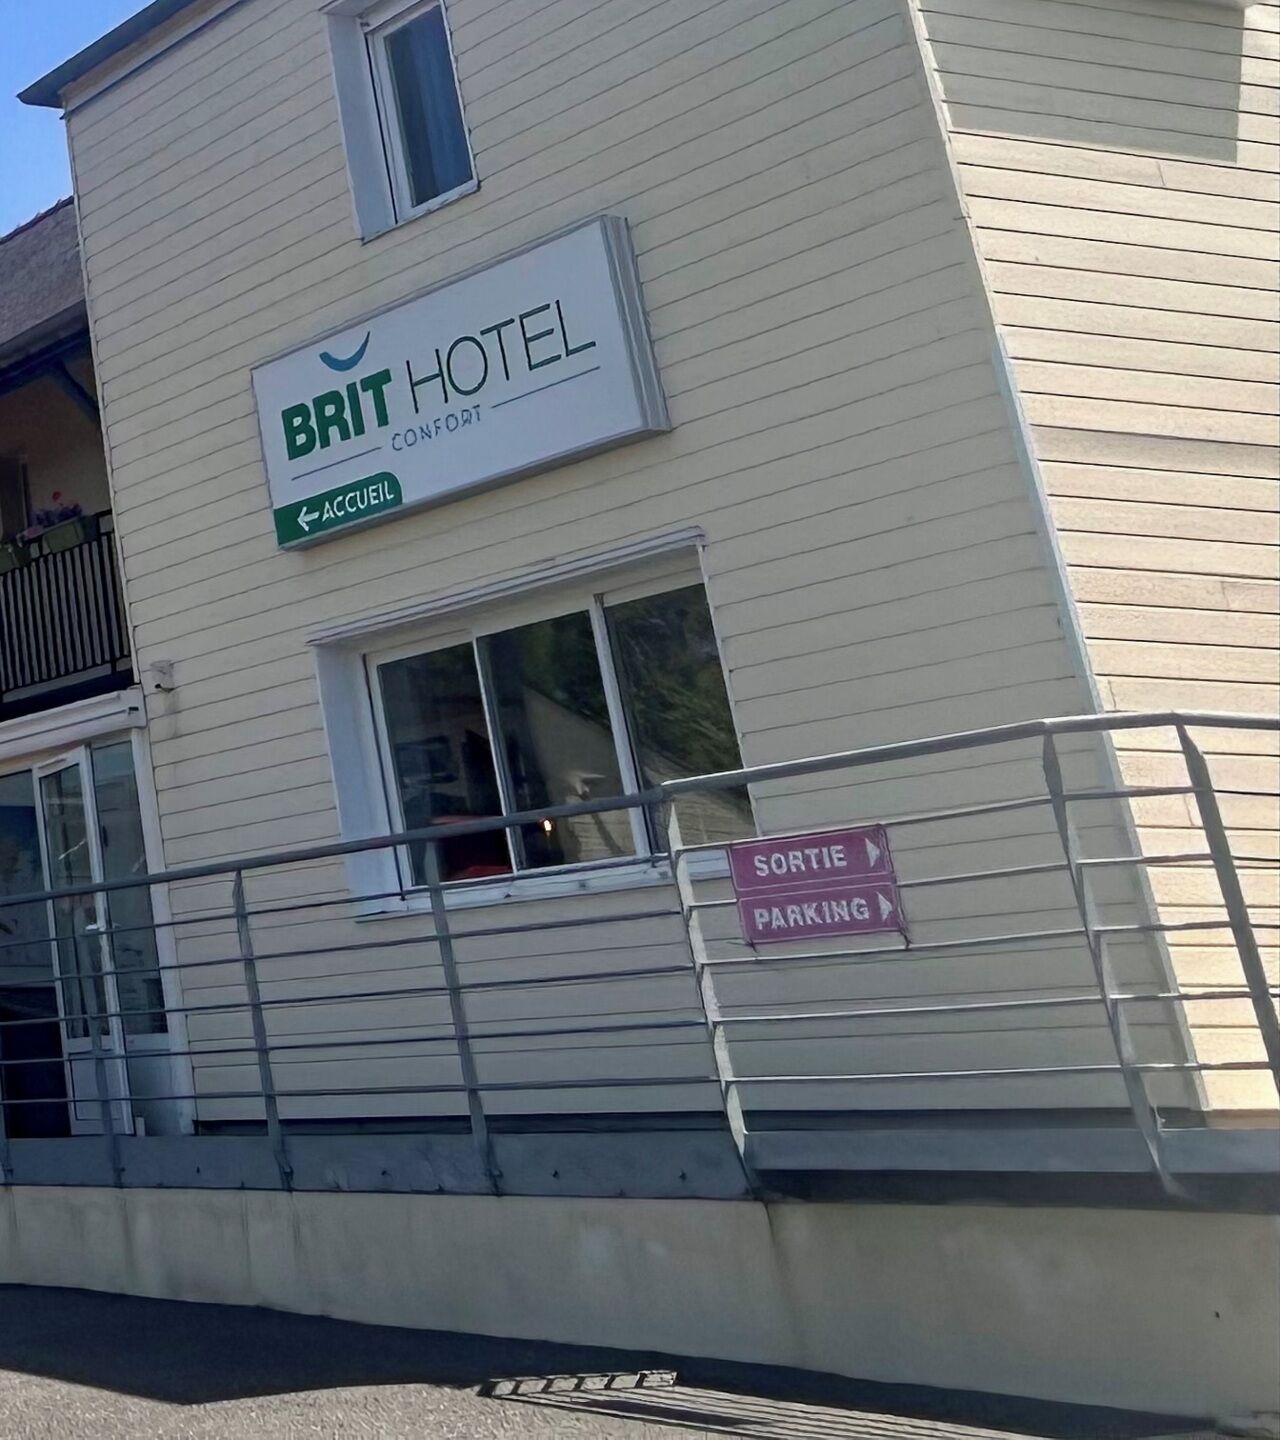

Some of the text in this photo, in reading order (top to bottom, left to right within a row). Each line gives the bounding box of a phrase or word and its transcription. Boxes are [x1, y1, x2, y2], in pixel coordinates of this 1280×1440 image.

[281, 300, 596, 461] BRIT HOTEL
[392, 404, 482, 451] CONFORT
[322, 480, 395, 522] ACCUEIL
[754, 845, 847, 877] SORTIE
[754, 897, 870, 930] PARKING
